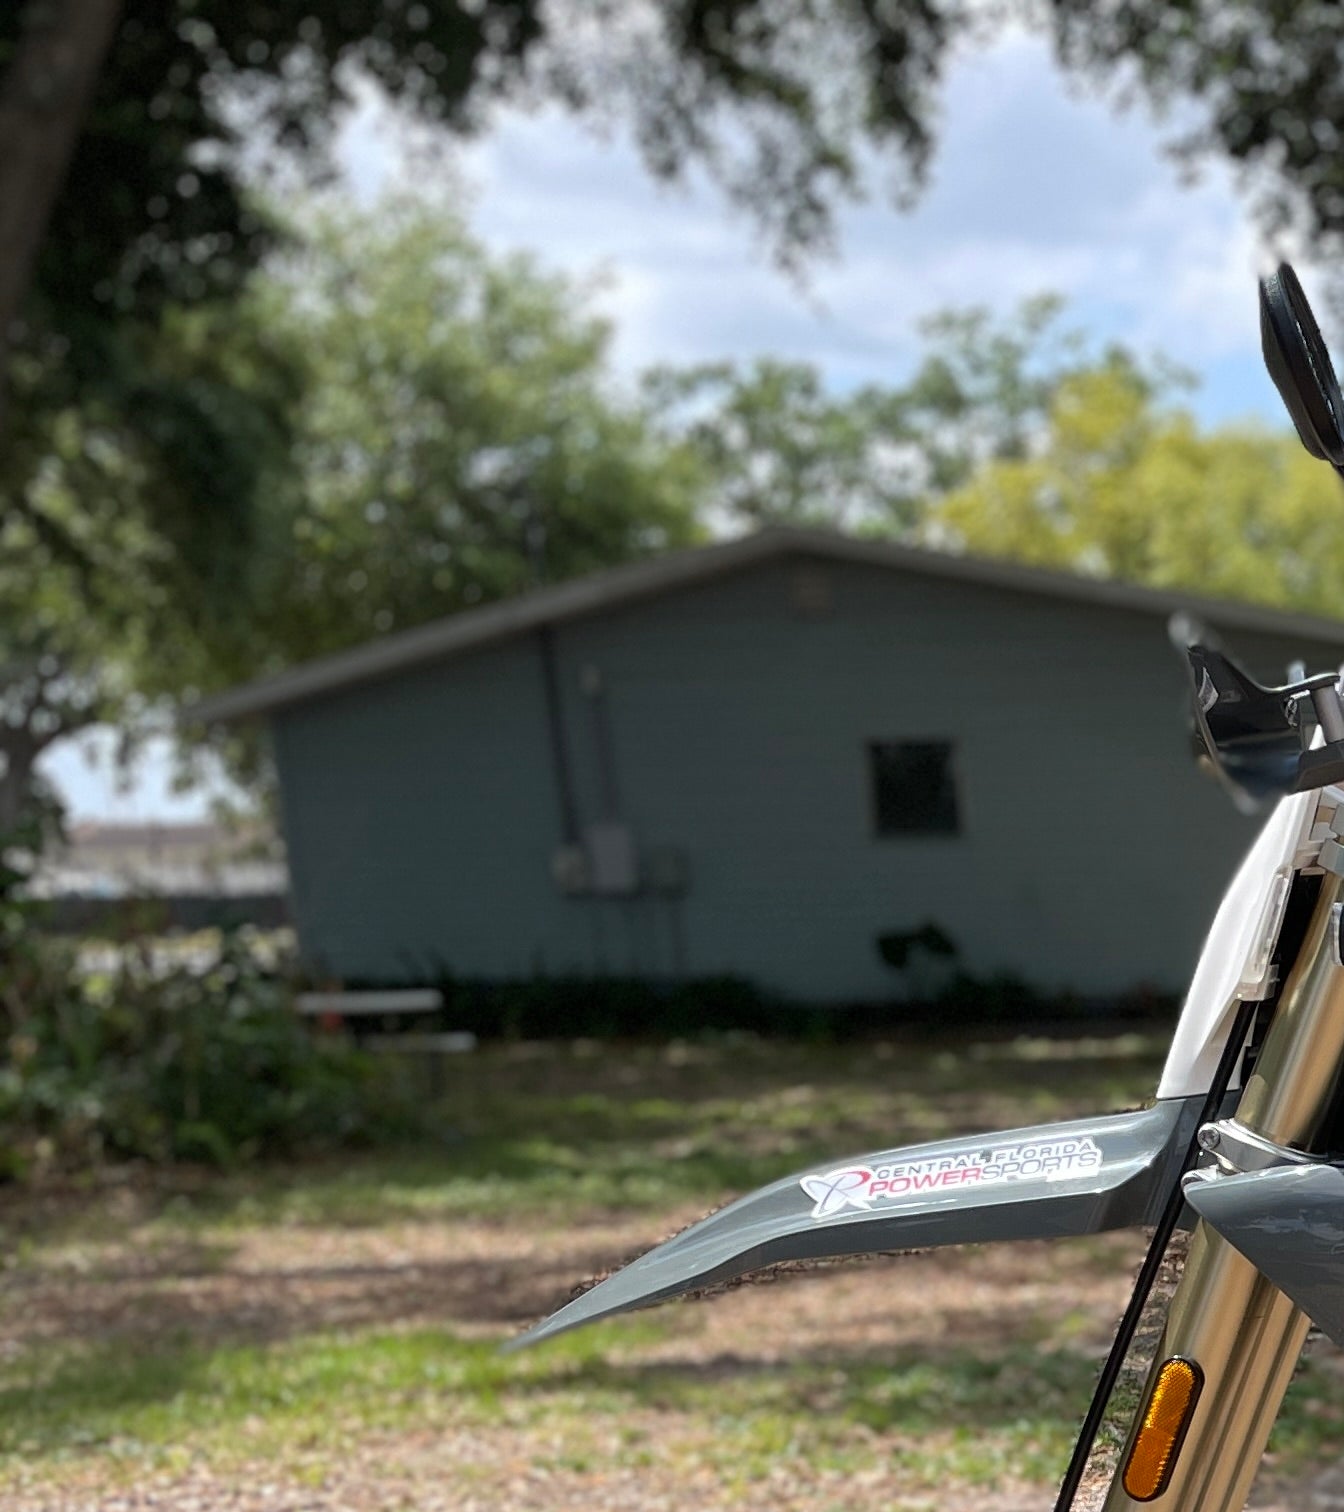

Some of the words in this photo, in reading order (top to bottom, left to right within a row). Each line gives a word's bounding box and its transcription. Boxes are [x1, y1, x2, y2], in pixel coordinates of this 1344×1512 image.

[868, 1150, 1099, 1197] POWERSPORTS
[878, 1153, 984, 1180] CENTRAL
[994, 1138, 1097, 1162] FLORIDA
